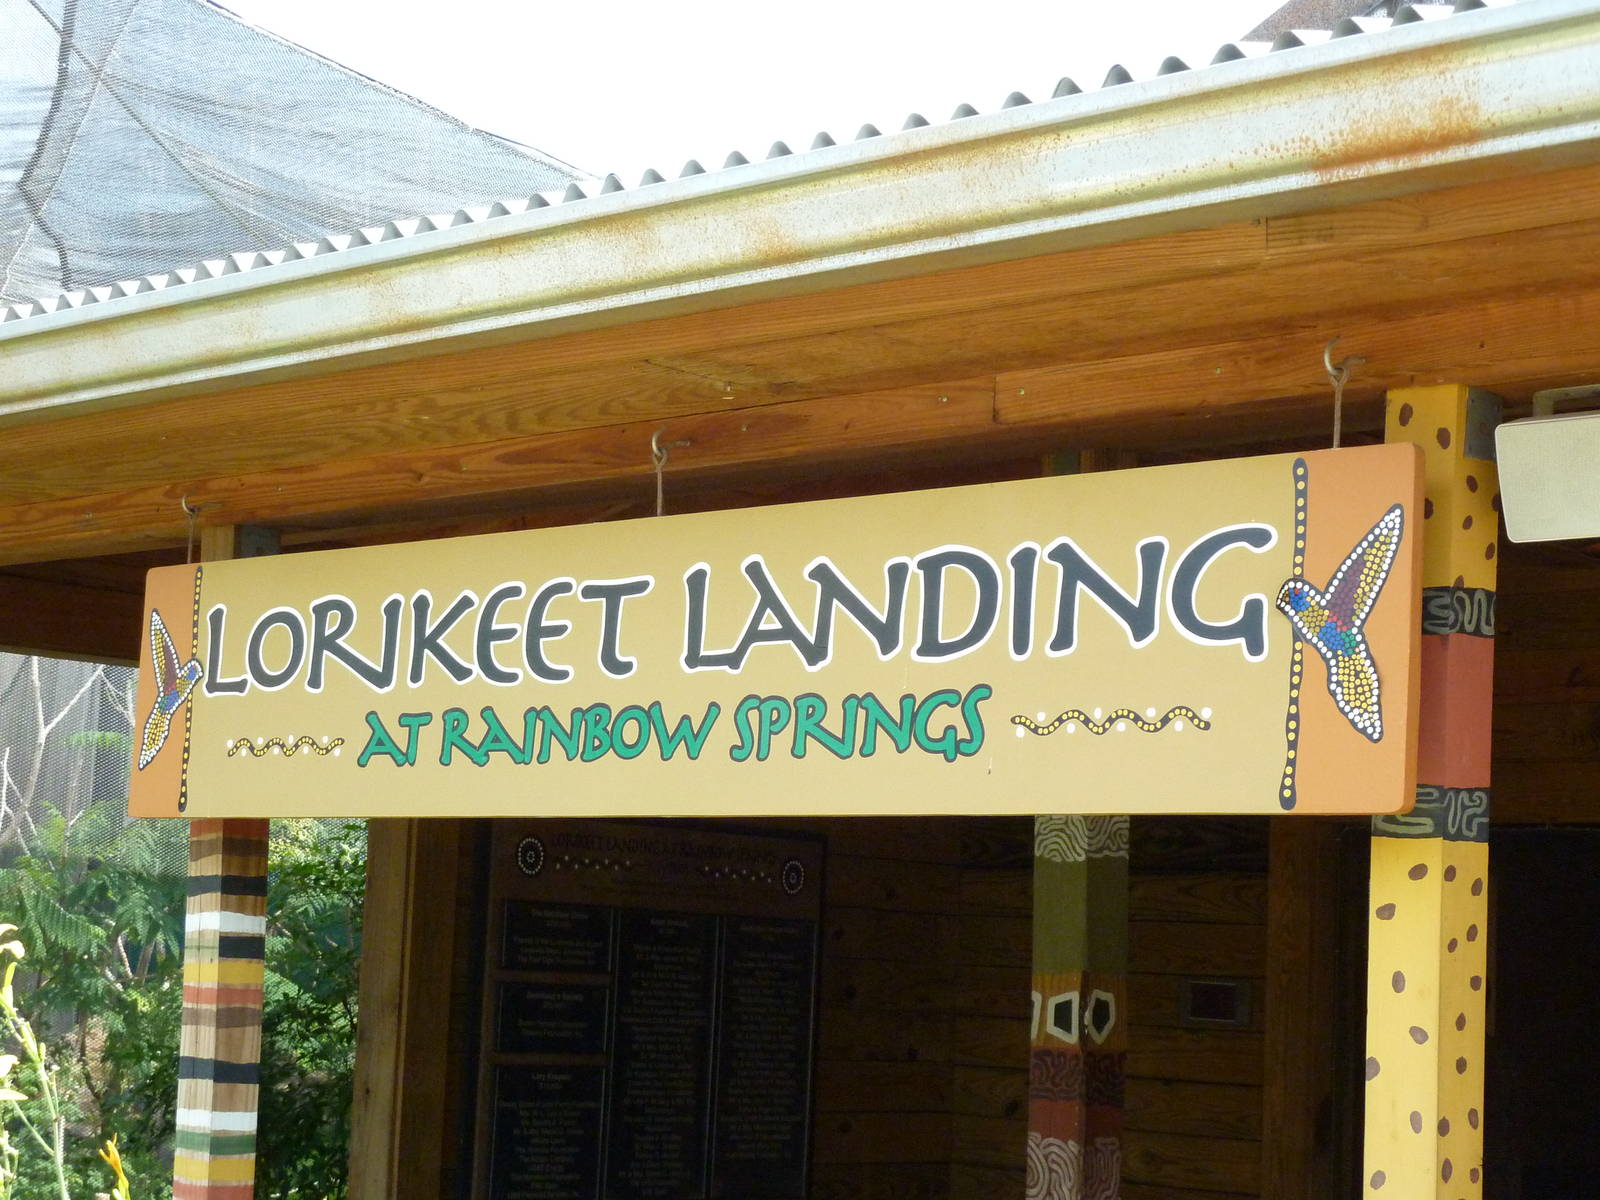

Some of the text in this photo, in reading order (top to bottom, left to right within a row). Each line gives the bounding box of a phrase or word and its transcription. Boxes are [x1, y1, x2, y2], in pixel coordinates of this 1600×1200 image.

[204, 522, 1277, 698] LORIKEET LANDING
[357, 684, 992, 767] AT RAINBOW SPRINGS
